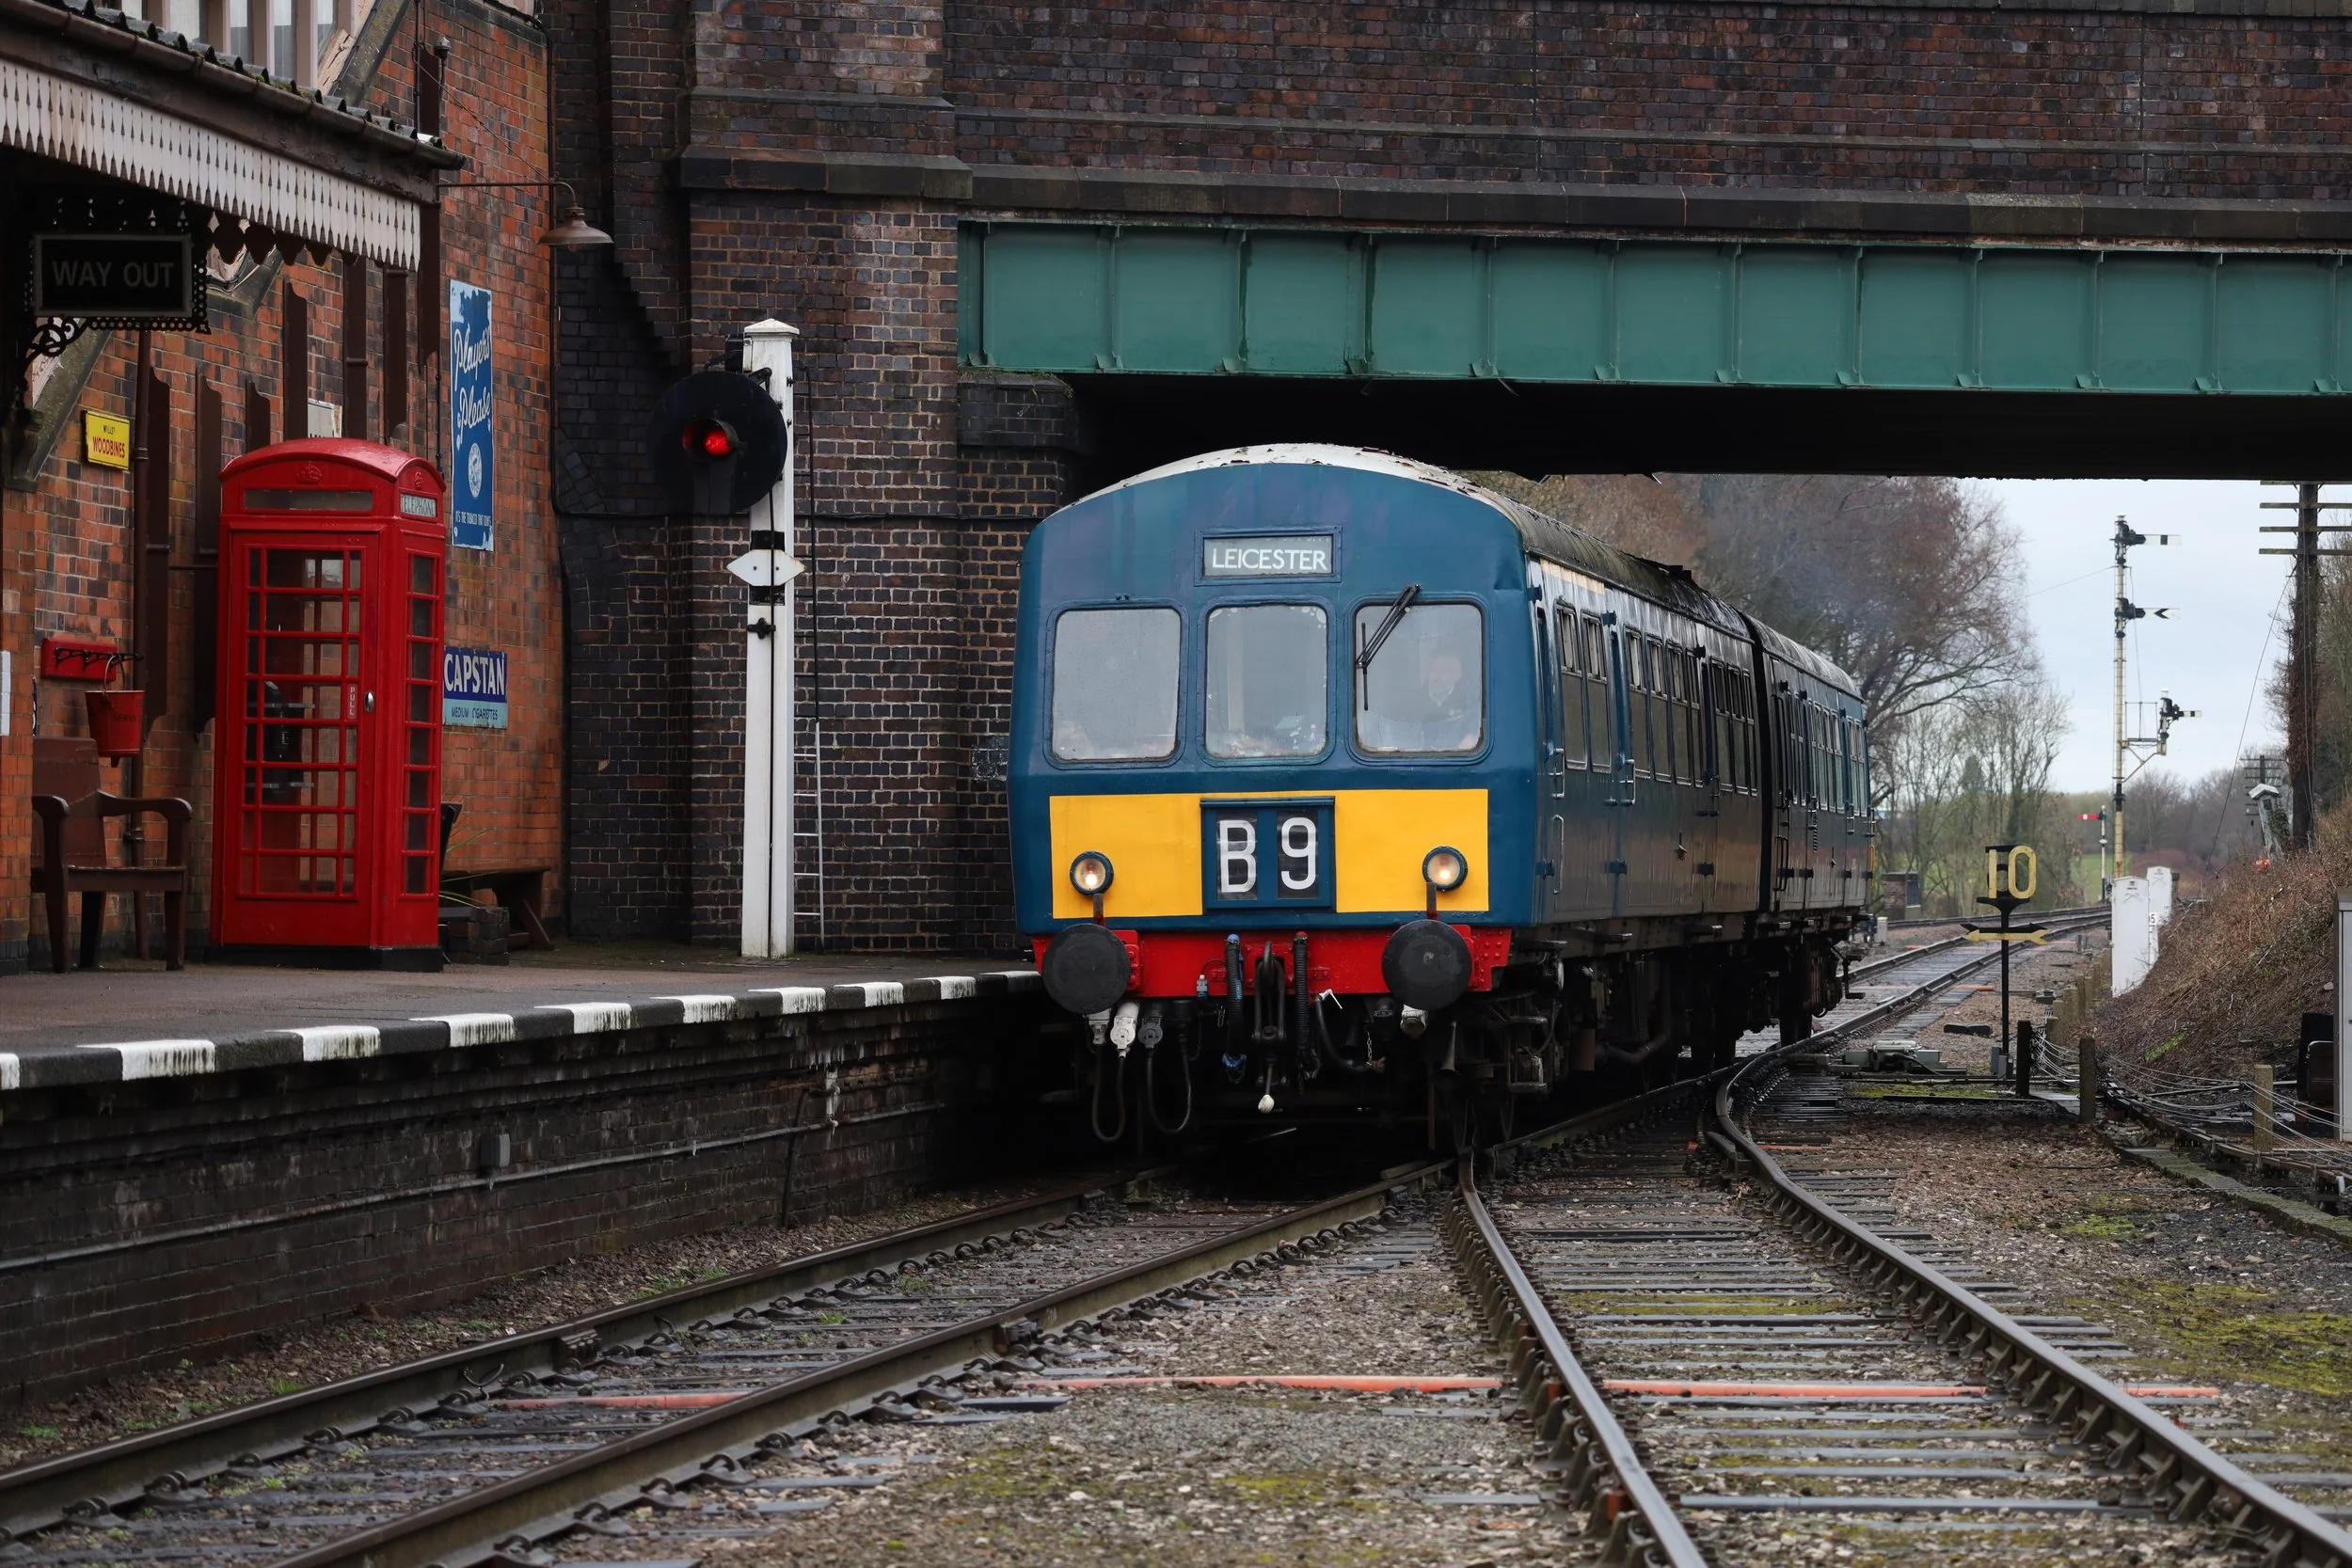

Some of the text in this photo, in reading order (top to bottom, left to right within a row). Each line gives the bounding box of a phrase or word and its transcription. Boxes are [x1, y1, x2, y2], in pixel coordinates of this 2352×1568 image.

[52, 260, 174, 288] WAY OUT
[459, 385, 490, 444] Please
[92, 436, 125, 458] WOODBINES
[1212, 547, 1327, 571] LEICESTER
[444, 653, 505, 696] CAPSTAN
[452, 706, 499, 721] MEDIUM CIGARETTES
[1219, 816, 1316, 893] B 9
[1988, 845, 2037, 899] 10
